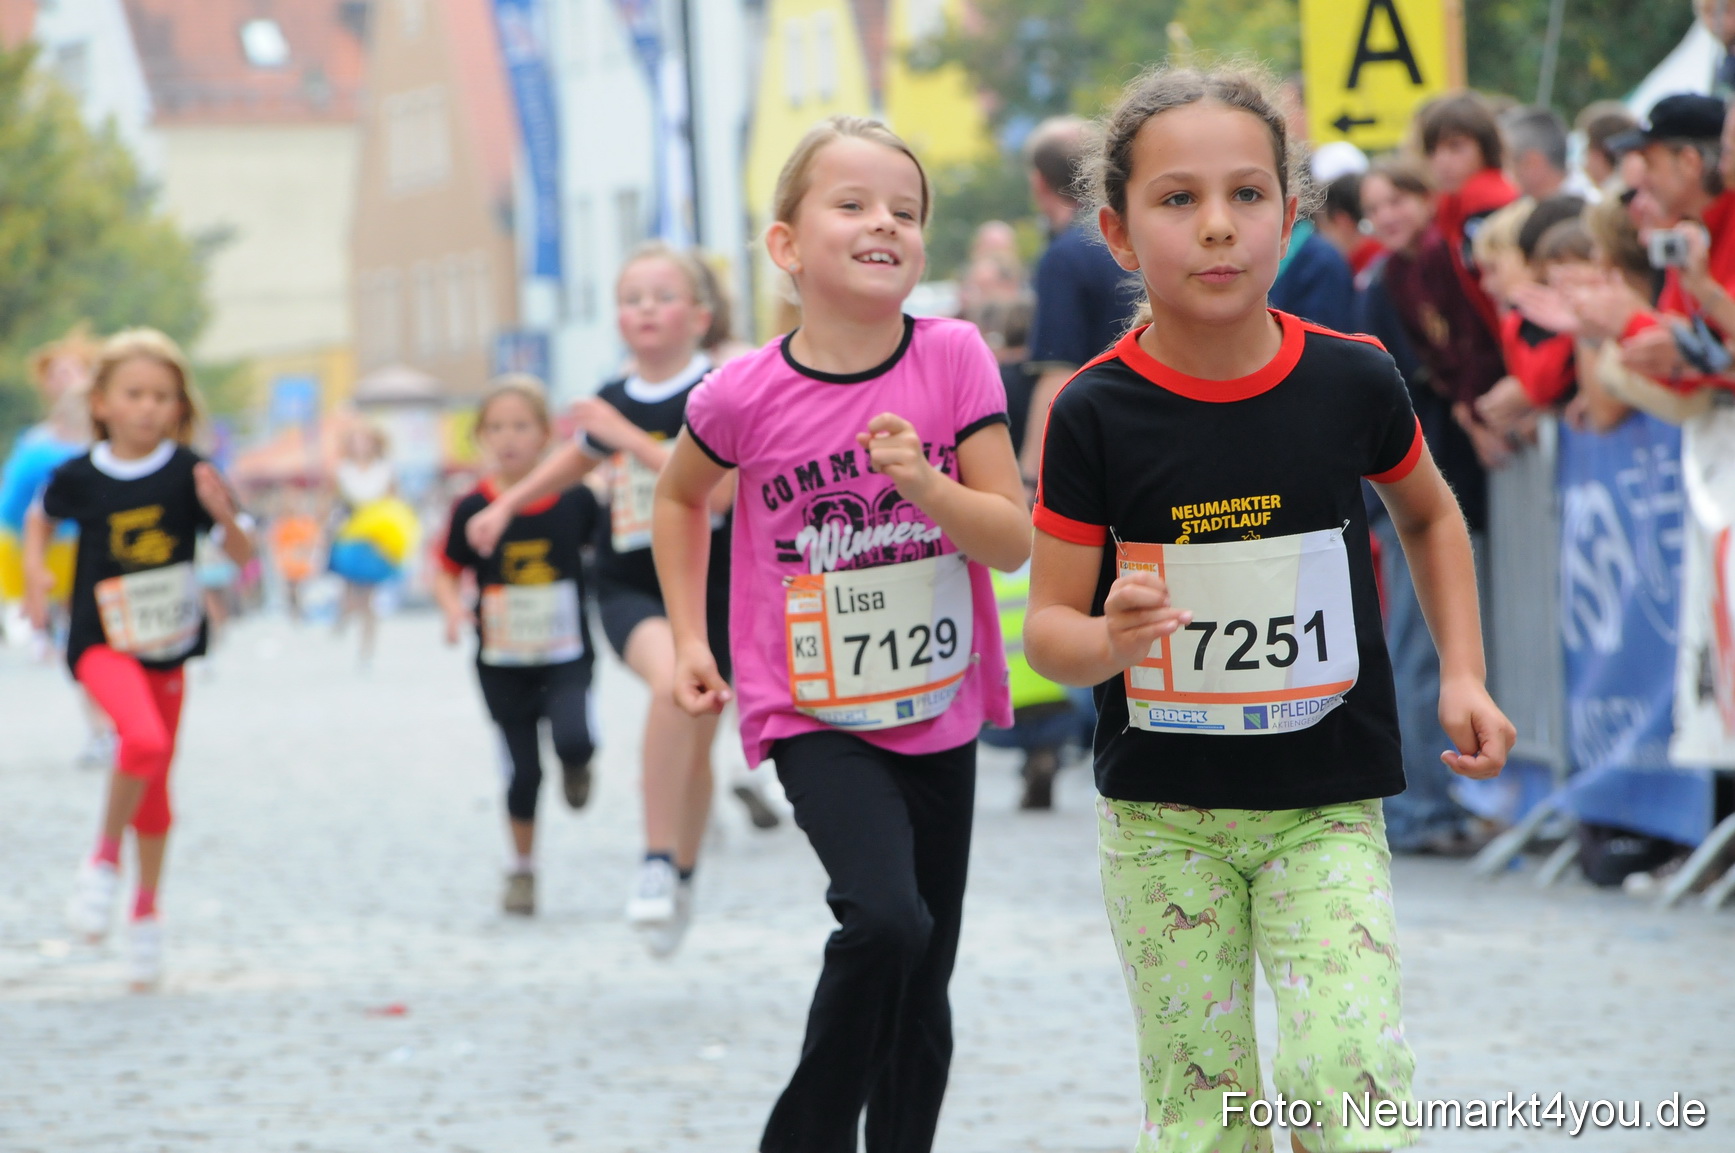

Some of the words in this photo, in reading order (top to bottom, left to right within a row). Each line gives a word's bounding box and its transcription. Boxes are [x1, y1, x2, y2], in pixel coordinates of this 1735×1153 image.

[1347, 0, 1422, 88] A
[1171, 495, 1281, 520] NEUMARKTER
[1182, 512, 1271, 535] STADTLAUF
[835, 586, 885, 614] Lisa
[795, 636, 818, 658] K3
[843, 617, 957, 676] 7129
[1184, 609, 1328, 671] 7251
[1149, 708, 1208, 724] BOCK
